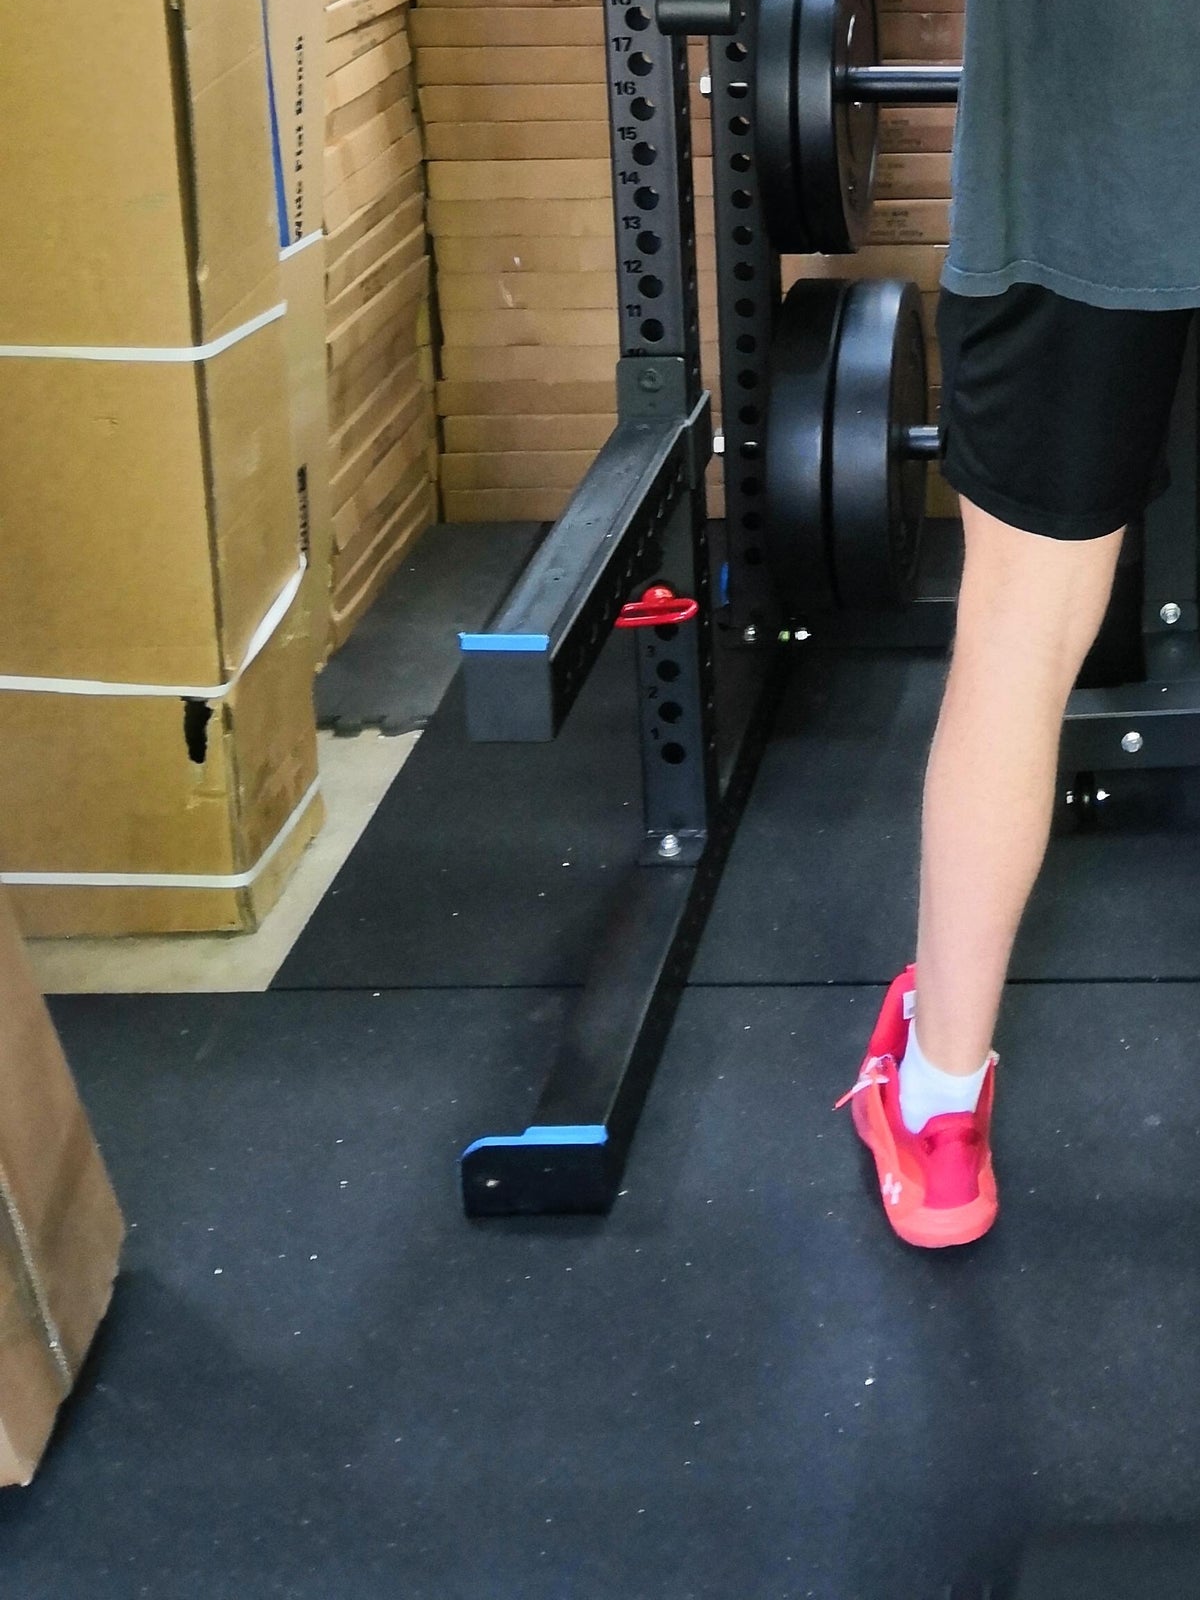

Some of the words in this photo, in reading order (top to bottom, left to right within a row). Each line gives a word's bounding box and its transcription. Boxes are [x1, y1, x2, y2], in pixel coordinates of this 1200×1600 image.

[612, 36, 633, 52] 17
[614, 81, 637, 96] 16
[617, 126, 637, 141] 15
[619, 171, 641, 185] 14
[622, 216, 642, 230] 13
[624, 260, 644, 273] 12
[626, 304, 642, 318] 11
